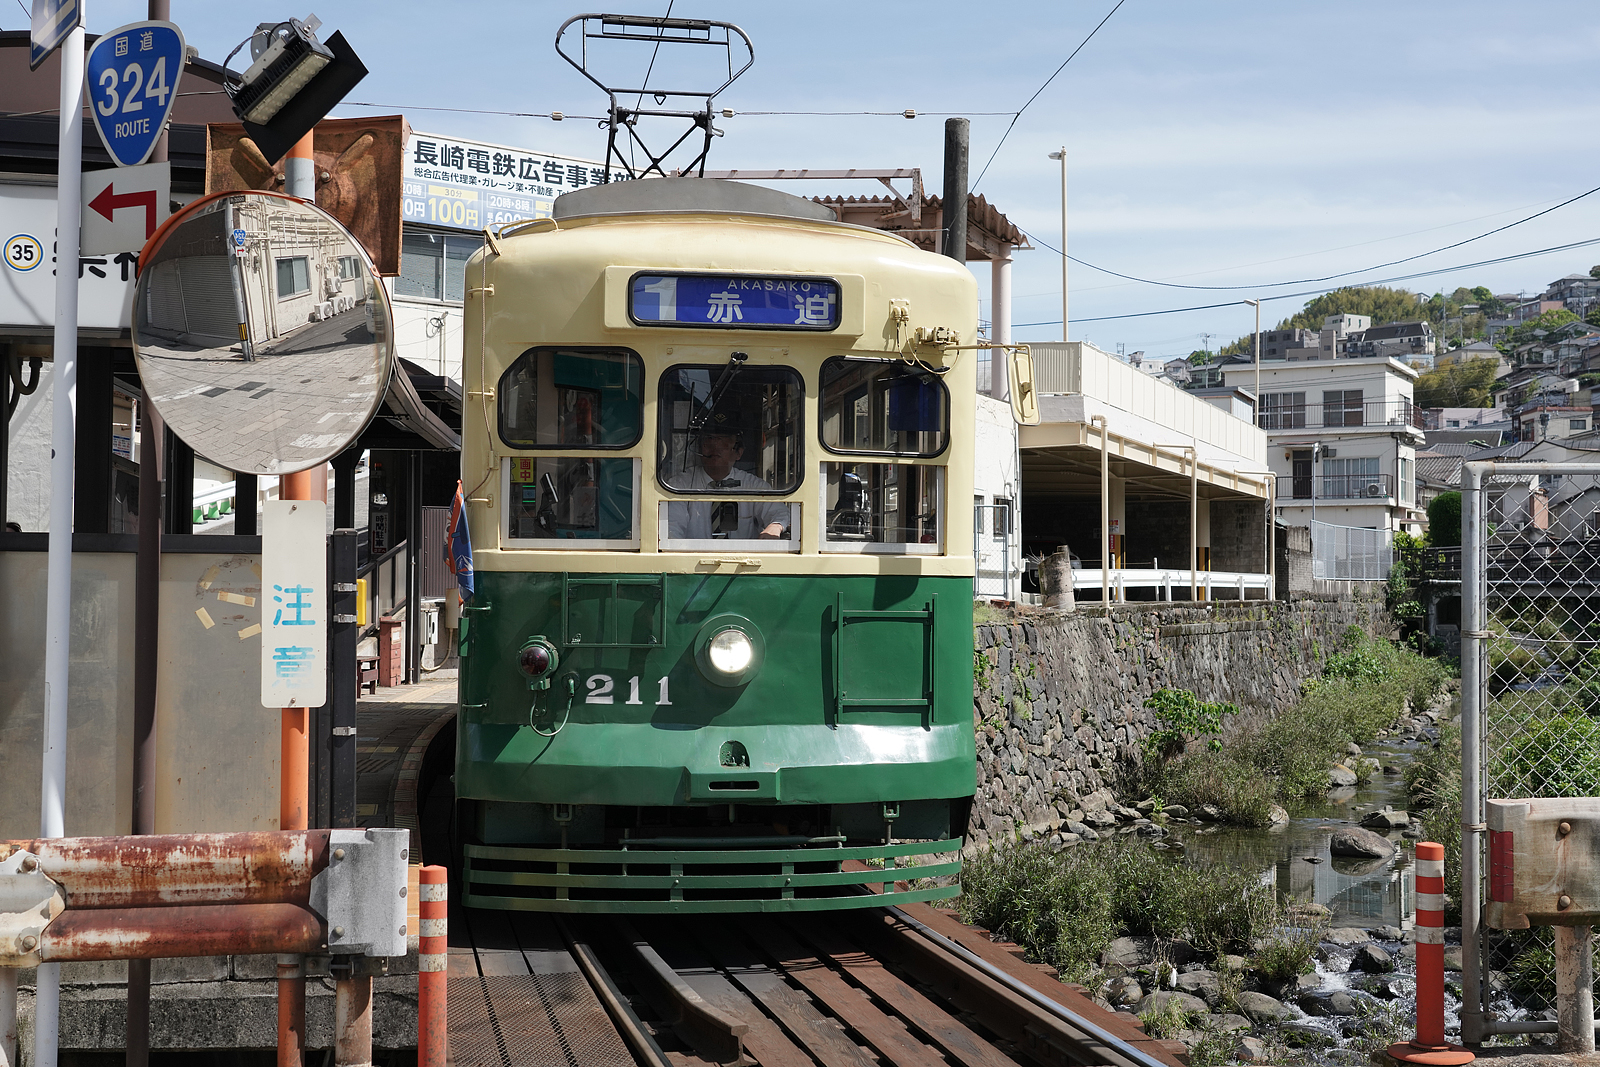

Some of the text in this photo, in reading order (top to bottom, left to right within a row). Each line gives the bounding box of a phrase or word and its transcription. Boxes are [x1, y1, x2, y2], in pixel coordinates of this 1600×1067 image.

[115, 31, 153, 57] 国道
[98, 56, 170, 117] 324
[115, 118, 150, 139] ROUTE
[444, 188, 463, 198] 30分
[428, 197, 479, 227] 100円
[12, 244, 34, 262] 35
[644, 277, 678, 321] 1
[727, 279, 811, 293] AKASAKO
[707, 291, 830, 325] 赤迫
[272, 584, 316, 689] 注意
[585, 674, 672, 706] 211
